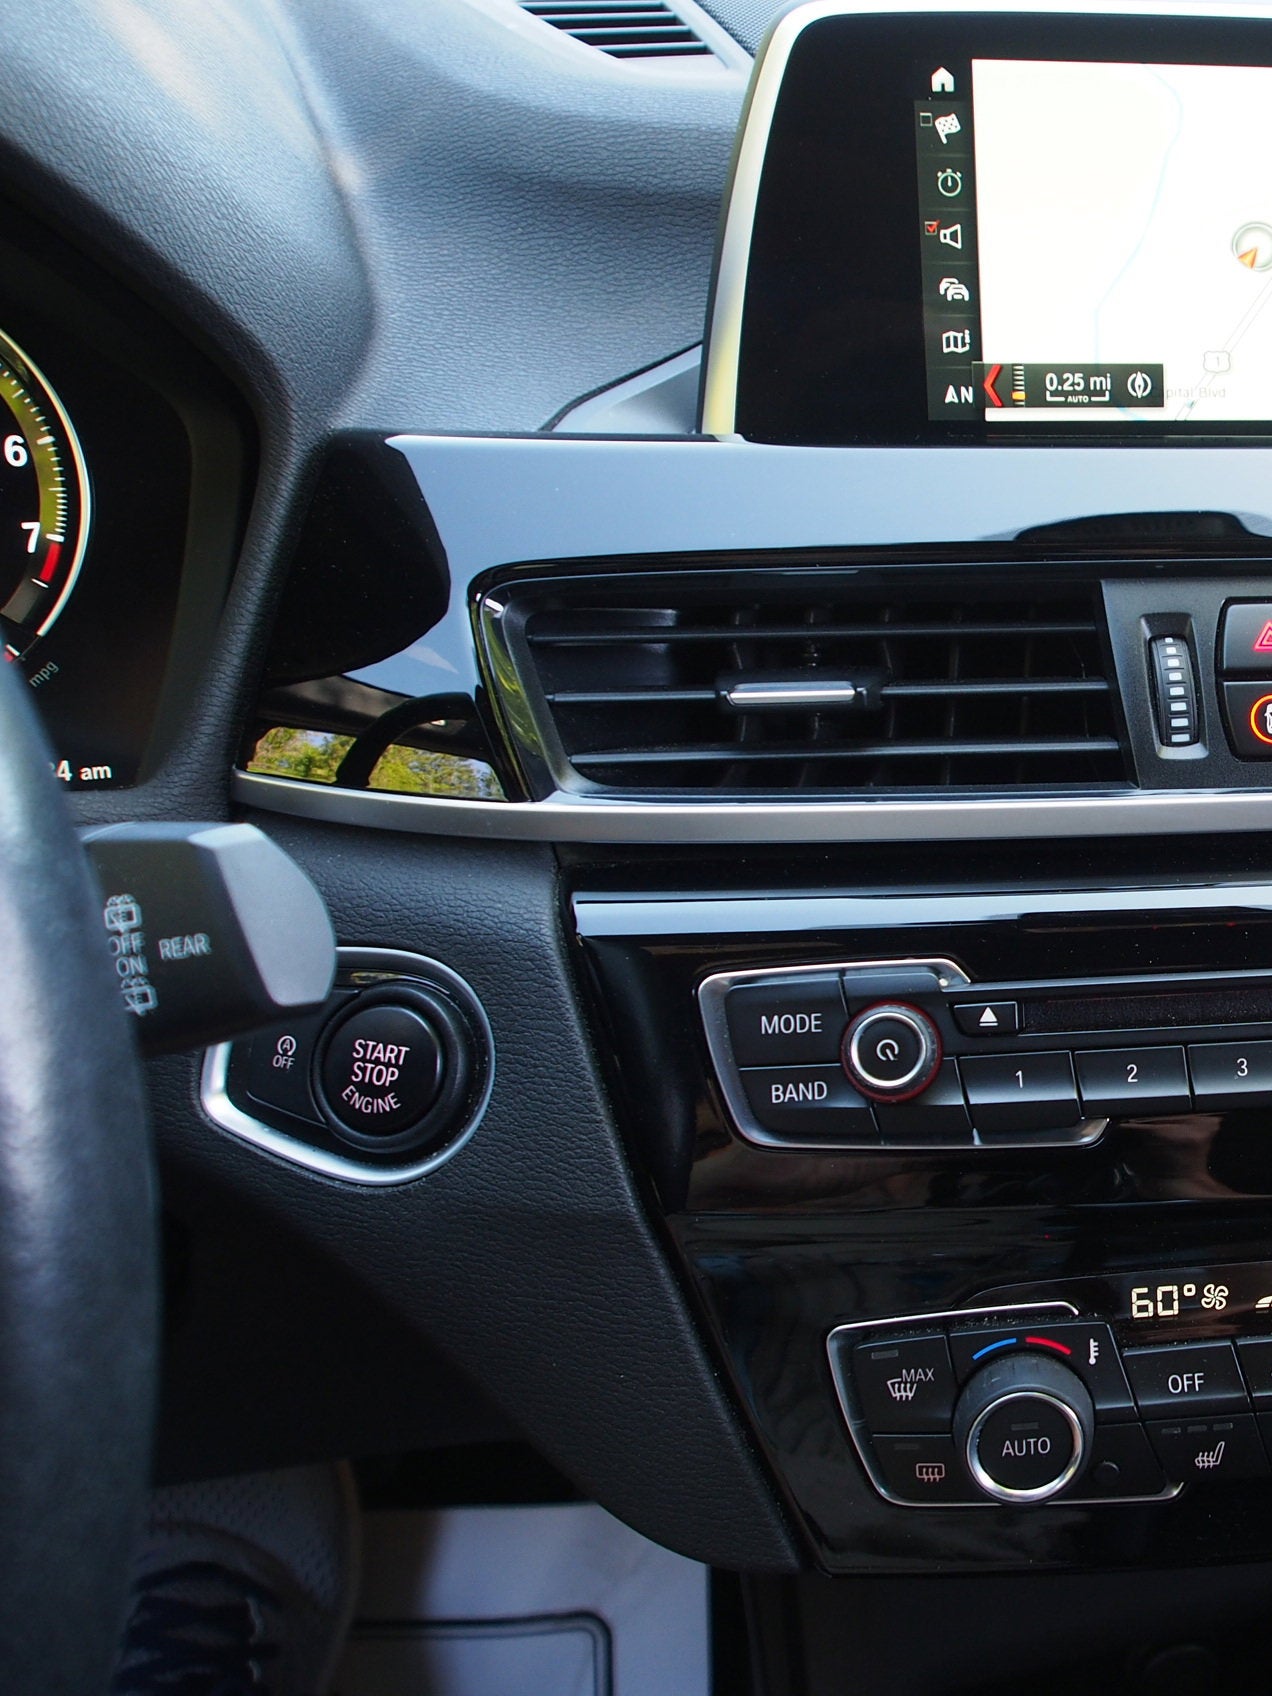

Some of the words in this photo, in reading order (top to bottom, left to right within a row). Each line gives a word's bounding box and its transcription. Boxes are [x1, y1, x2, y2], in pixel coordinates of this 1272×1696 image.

[1045, 372, 1085, 392] 0.25
[1090, 372, 1112, 392] mi
[1067, 395, 1090, 404] AUTO
[1163, 387, 1194, 401] pital
[3, 434, 28, 467] 6
[20, 522, 41, 554] 7
[29, 661, 60, 688] mpg
[79, 765, 112, 781] am
[107, 931, 145, 957] OFF
[158, 933, 212, 960] REAR
[116, 955, 149, 978] ON
[761, 1013, 823, 1035] MODE
[272, 1055, 296, 1069] OFF
[352, 1039, 410, 1066] START
[351, 1060, 400, 1087] STOP
[1126, 1063, 1138, 1084] 2
[1236, 1057, 1248, 1077] 3
[1015, 1070, 1024, 1089] 1
[341, 1085, 401, 1114] ENGINE
[770, 1081, 828, 1104] BAND
[902, 1368, 935, 1382] MAX
[1168, 1372, 1205, 1394] OFF
[1001, 1437, 1051, 1457] AUTO
